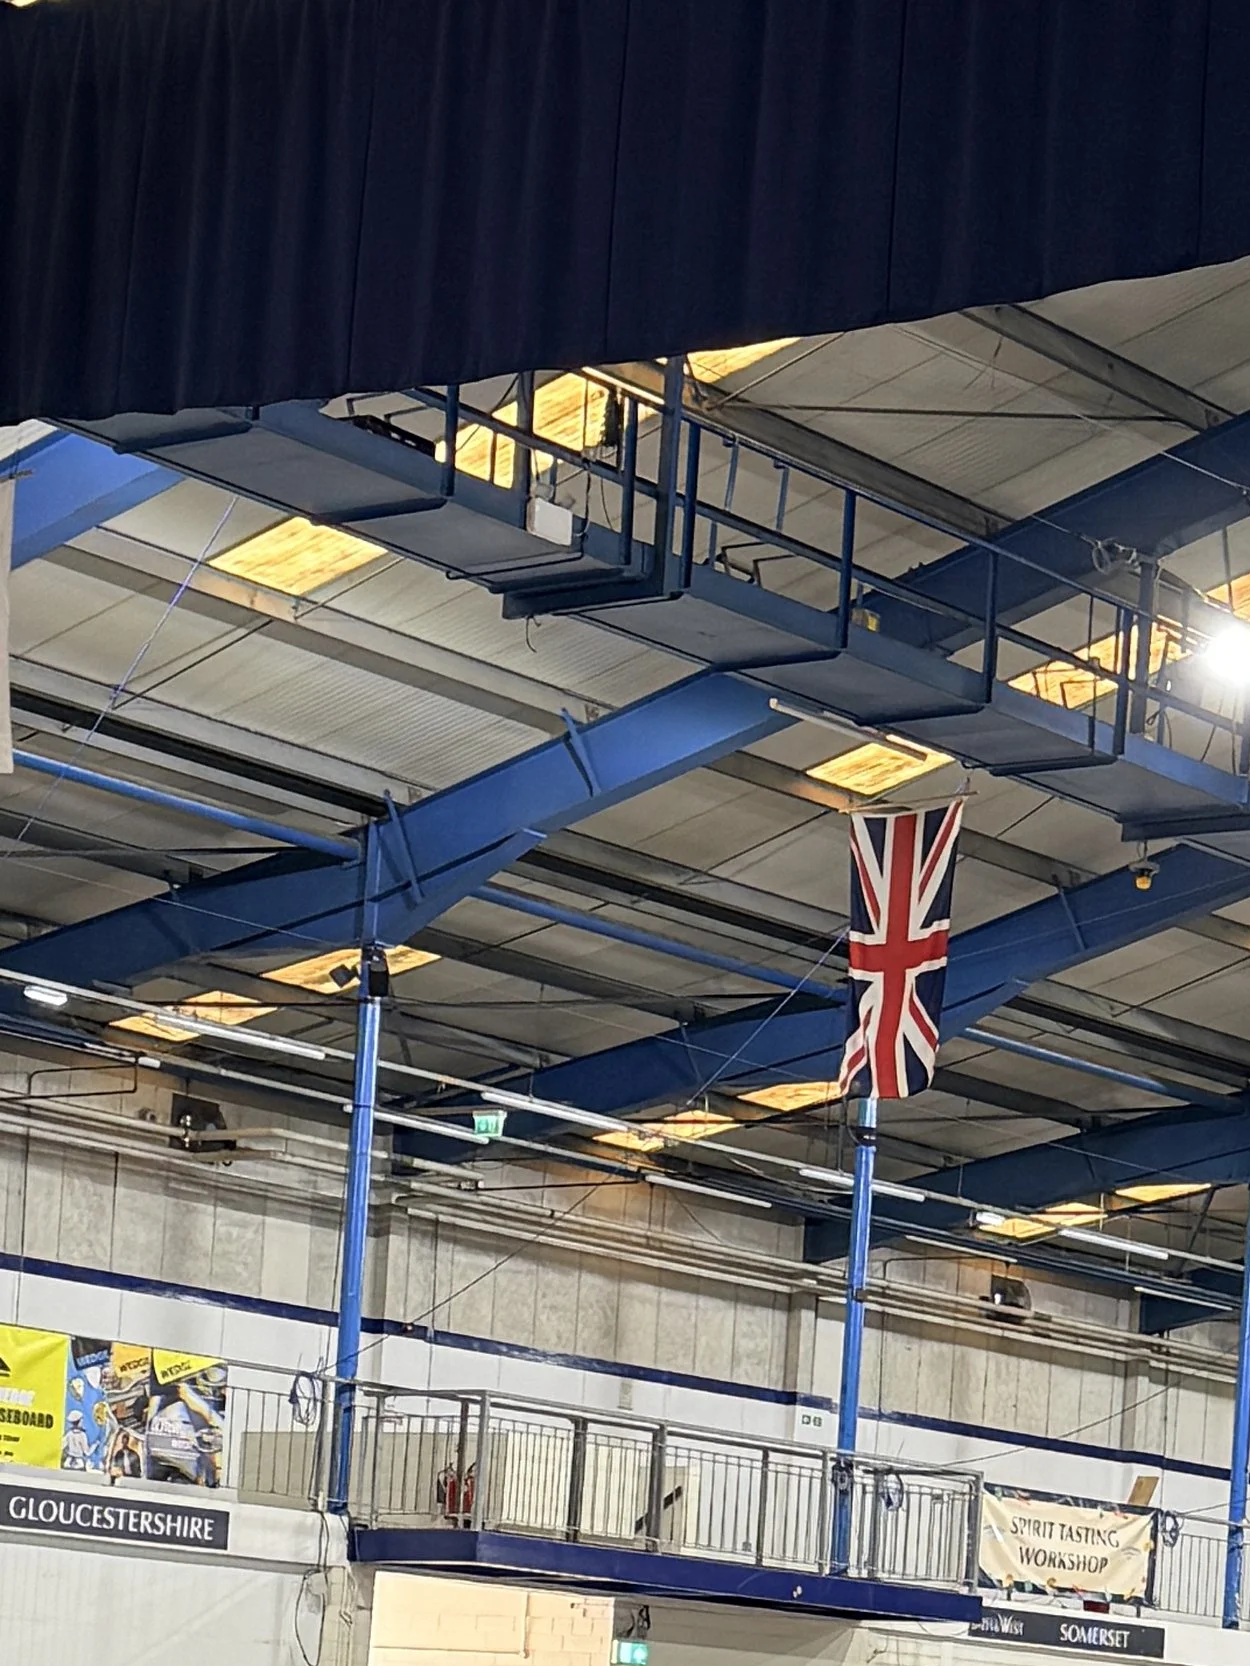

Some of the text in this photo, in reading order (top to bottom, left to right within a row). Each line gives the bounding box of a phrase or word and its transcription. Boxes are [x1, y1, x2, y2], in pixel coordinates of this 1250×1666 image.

[9, 1496, 215, 1540] GLOUCESTERSHIRE
[1010, 1516, 1120, 1549] SPIRIT TASTING
[1019, 1546, 1109, 1575] WORKSHOP
[1060, 1623, 1130, 1648] SOMERSET
